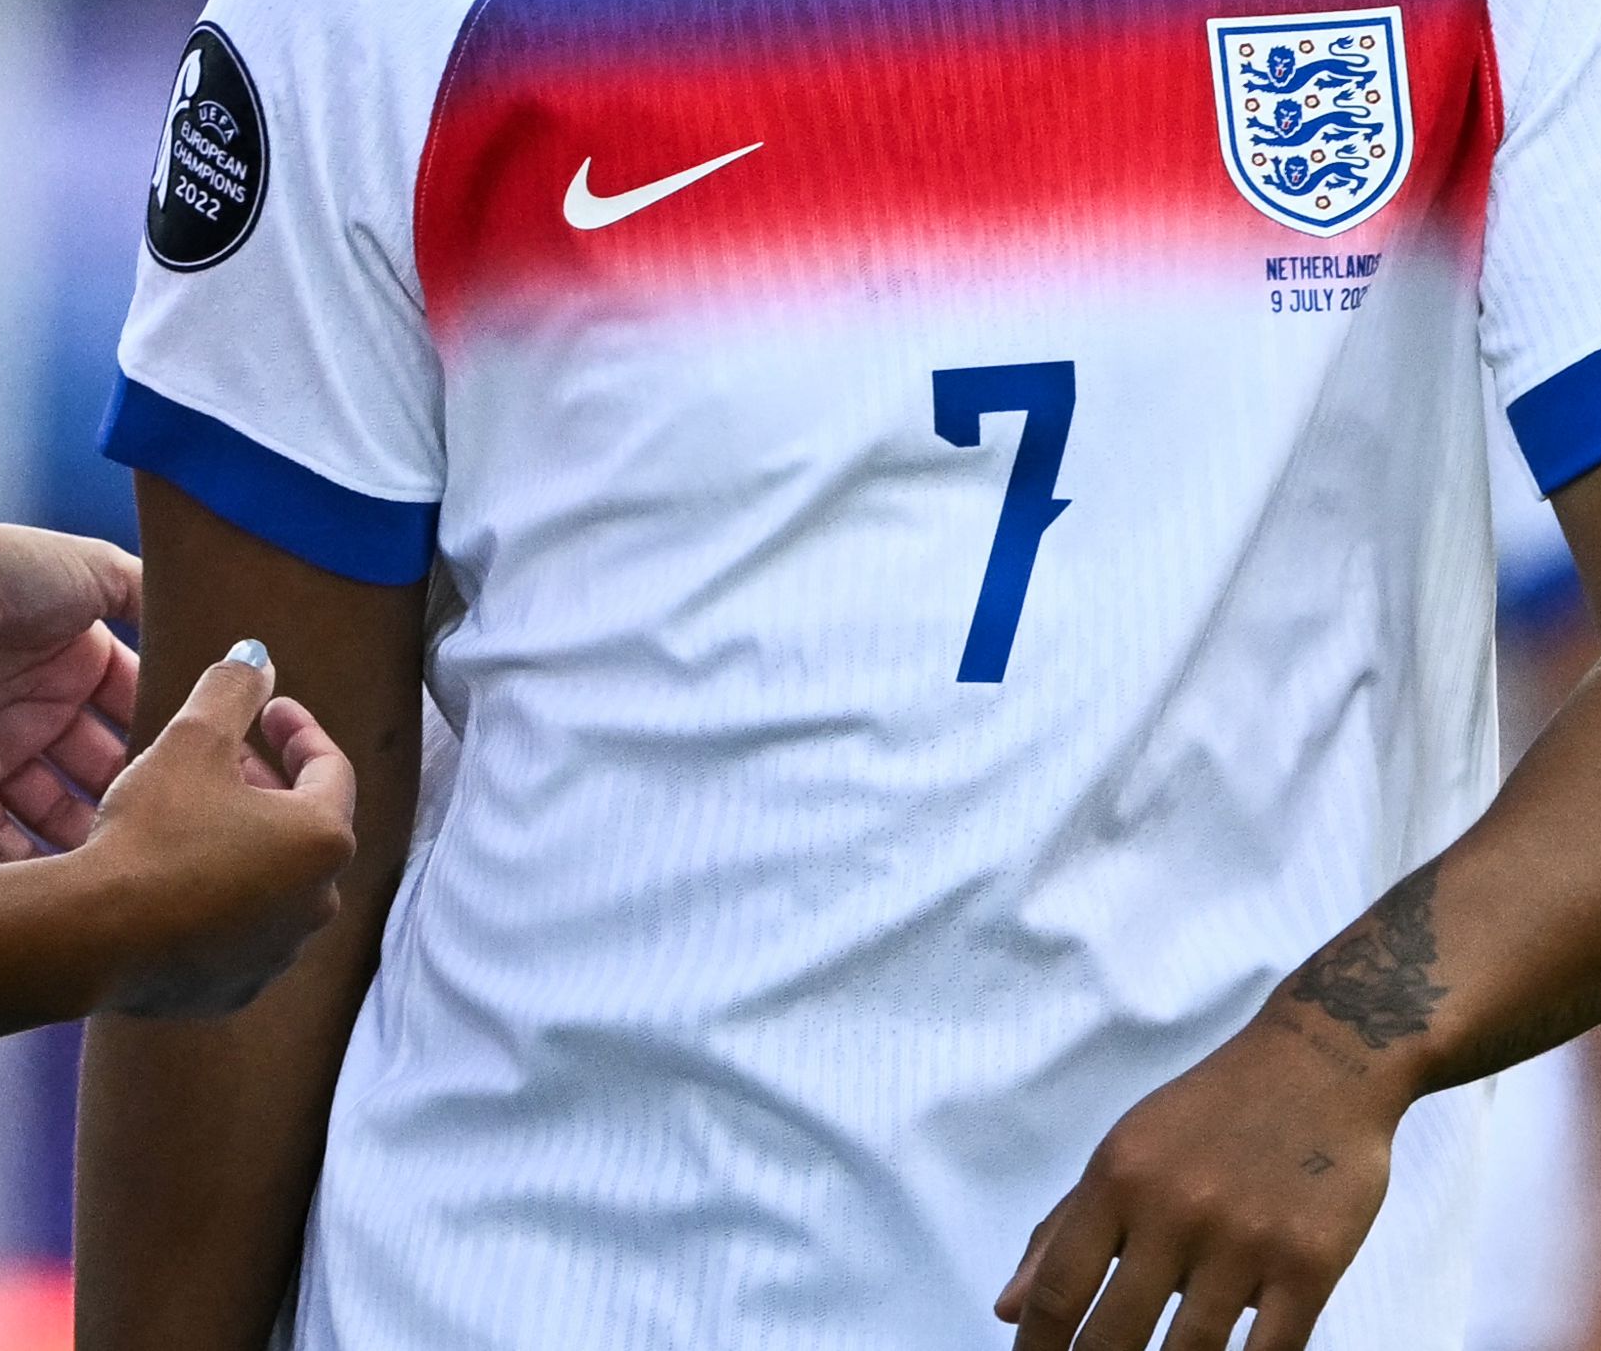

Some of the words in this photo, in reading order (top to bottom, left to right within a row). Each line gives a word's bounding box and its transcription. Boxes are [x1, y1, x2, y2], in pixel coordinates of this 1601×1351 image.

[199, 107, 234, 142] UEFA
[173, 140, 246, 203] CHAMPIONS
[181, 121, 248, 181] EUROPEAN
[174, 176, 222, 221] 2022
[1271, 290, 1283, 313] 9
[1290, 288, 1334, 313] JULY
[1340, 284, 1371, 311] 202
[932, 360, 1076, 683] 7
